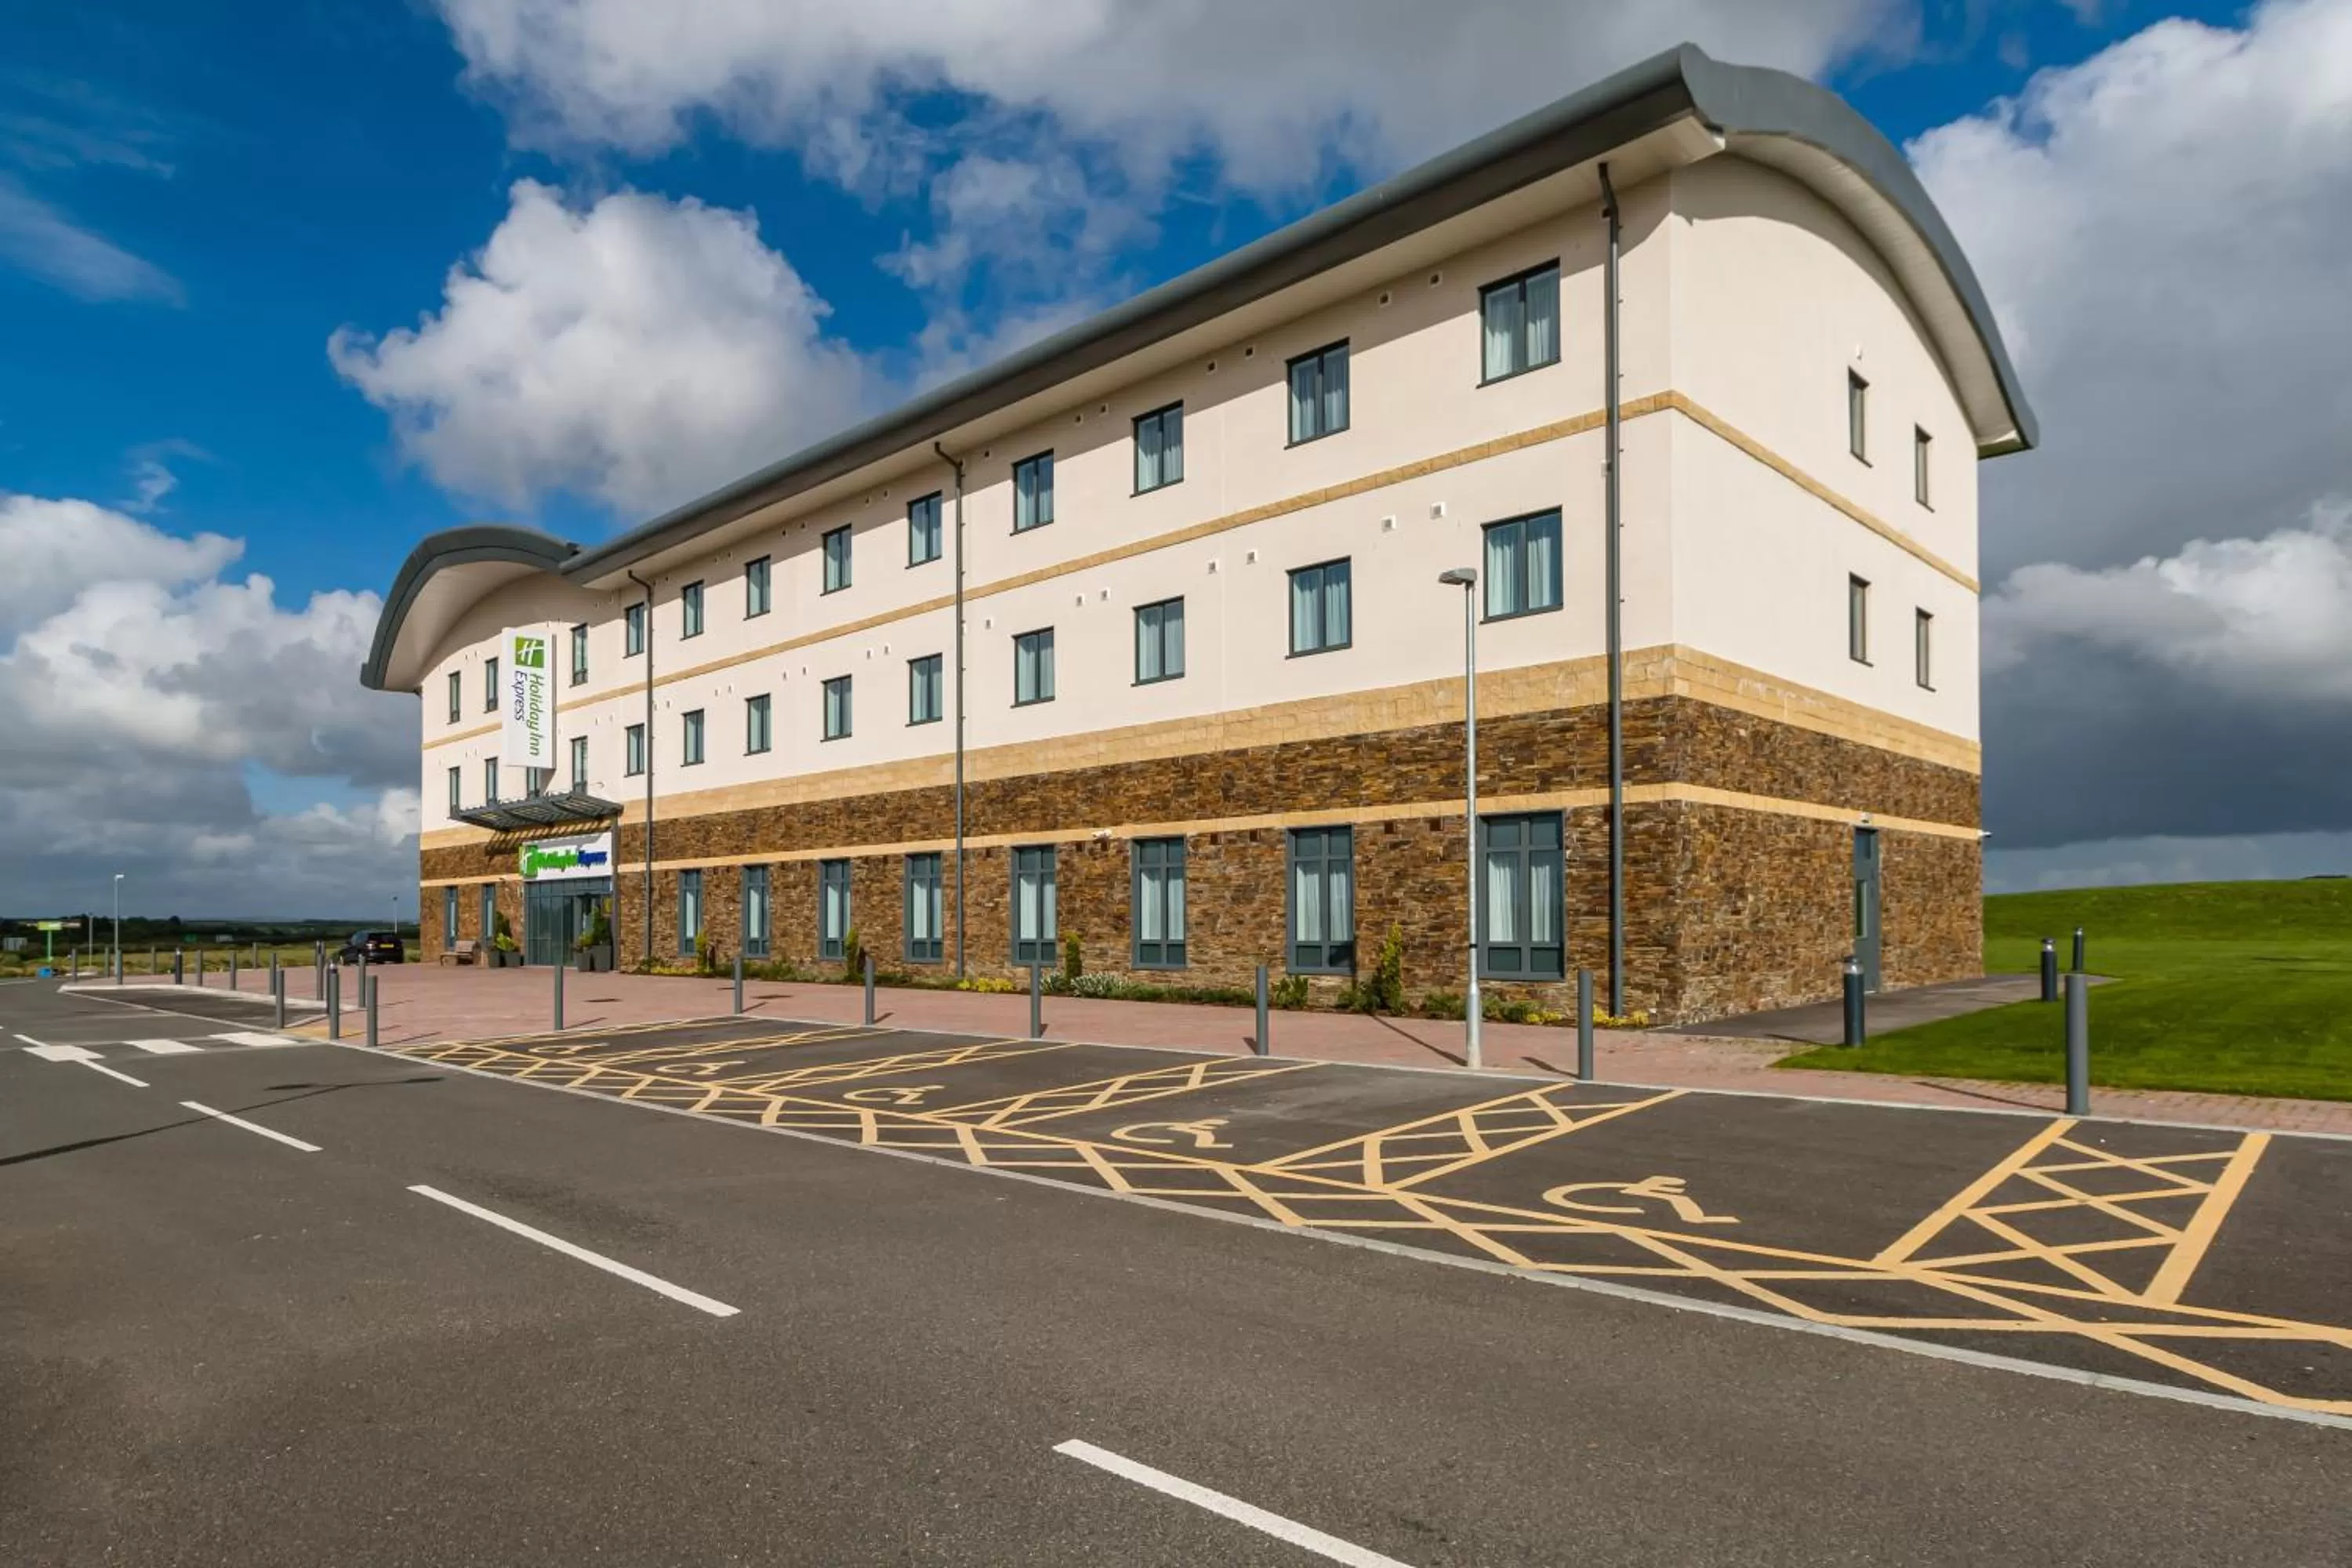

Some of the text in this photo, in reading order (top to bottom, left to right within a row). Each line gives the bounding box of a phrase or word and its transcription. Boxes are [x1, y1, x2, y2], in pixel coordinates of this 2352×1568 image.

[511, 670, 528, 723] Express
[527, 673, 545, 757] Holiday Inn
